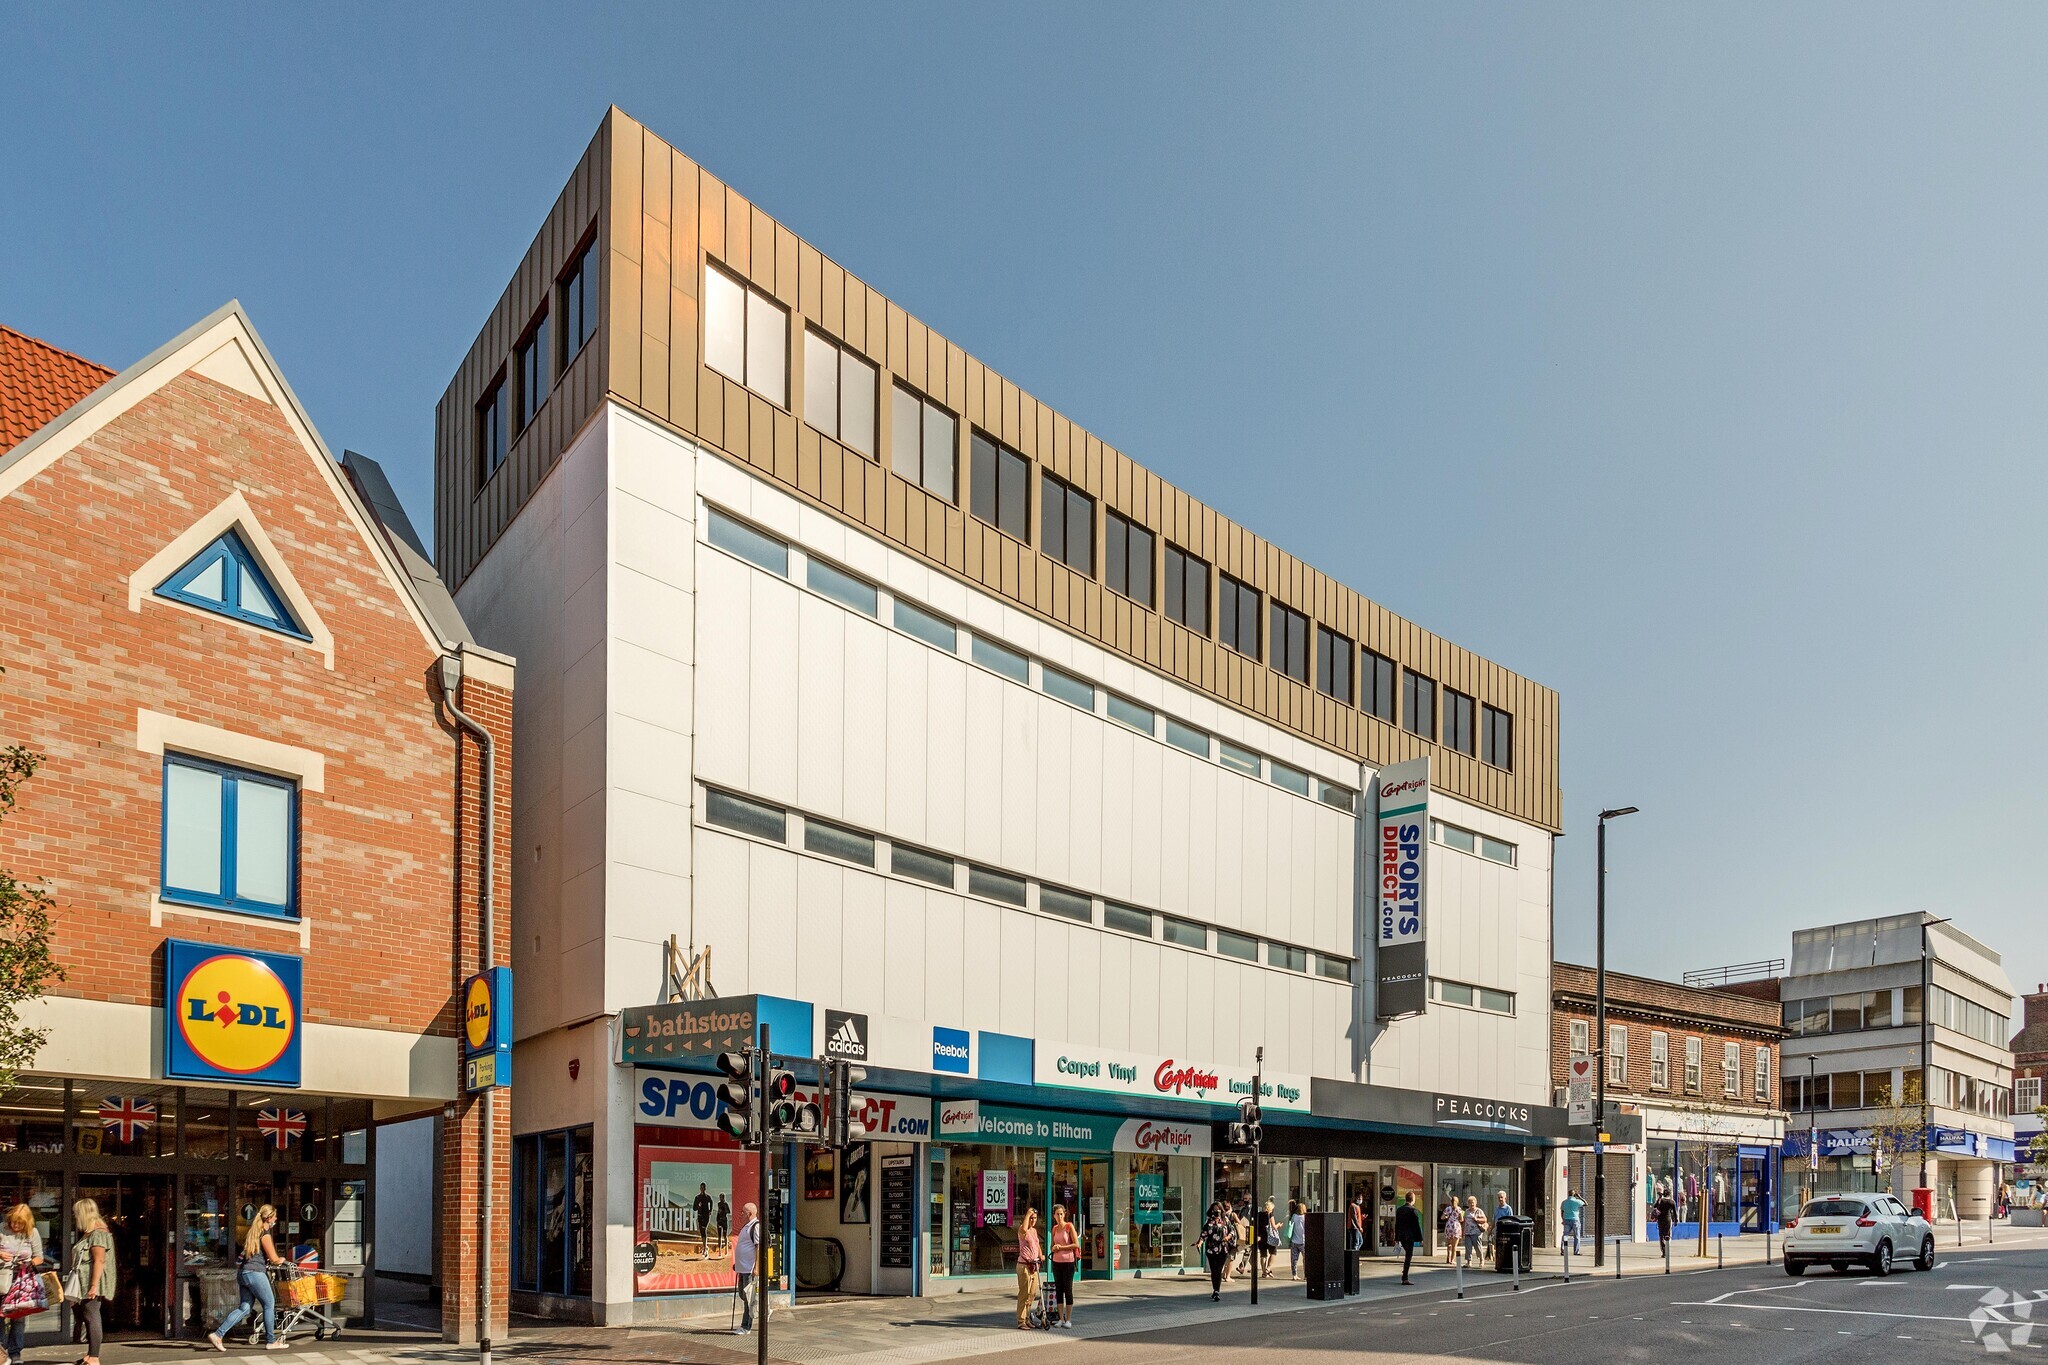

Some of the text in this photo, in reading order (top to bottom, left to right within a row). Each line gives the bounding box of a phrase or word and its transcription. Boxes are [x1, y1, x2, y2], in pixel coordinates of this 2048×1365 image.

[1382, 826, 1399, 940] DIRECT.COM
[1399, 823, 1420, 936] SPORTS
[1381, 973, 1422, 982] PEACOCKS
[646, 1010, 753, 1038] bathstore
[828, 1039, 865, 1056] adidas
[934, 1042, 968, 1059] Reebok
[468, 1061, 477, 1088] P
[479, 1062, 493, 1073] Parking
[1057, 1055, 1137, 1084] Carpet Vinyl
[1277, 1083, 1301, 1104] Rugs
[1436, 1098, 1529, 1122] PEACOCKS
[1037, 1120, 1050, 1137] to
[1052, 1121, 1093, 1140] Eltham
[998, 1174, 1007, 1184] big
[643, 1183, 670, 1208] RUN
[1138, 1184, 1153, 1198] 0%
[642, 1207, 698, 1231] FURTHER
